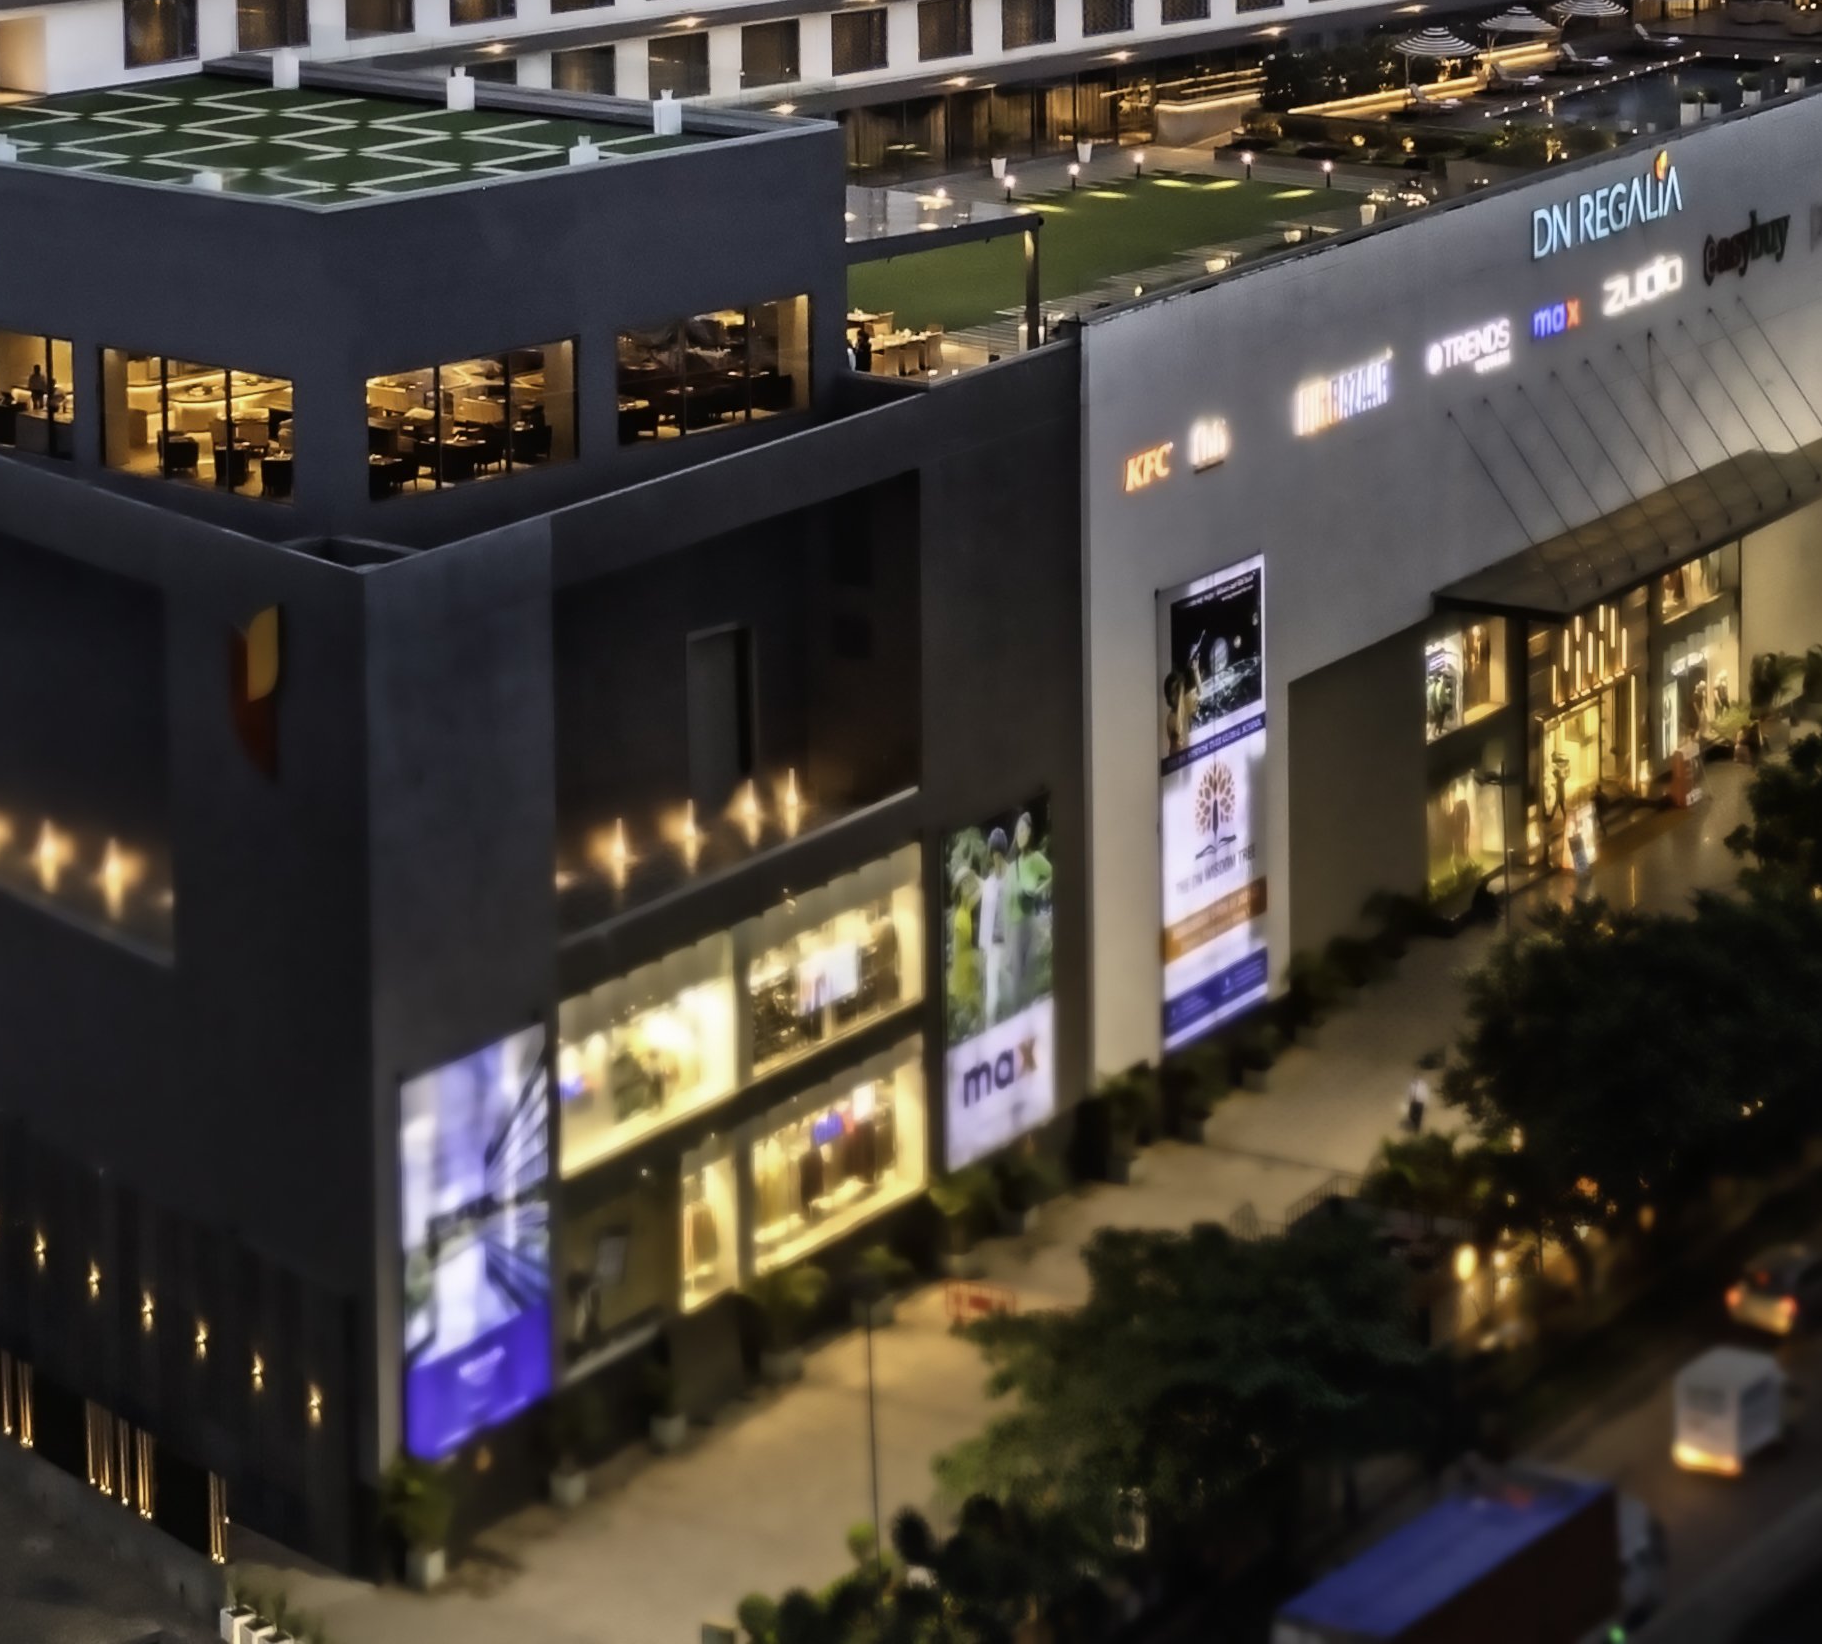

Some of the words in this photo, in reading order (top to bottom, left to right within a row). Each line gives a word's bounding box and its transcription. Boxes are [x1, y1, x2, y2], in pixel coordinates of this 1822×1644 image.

[1533, 202, 1572, 259] DN
[1580, 156, 1683, 244] REGALIA
[1442, 318, 1511, 368] TRENDS
[1534, 299, 1580, 337] max
[1125, 442, 1172, 492] KFC
[963, 1037, 1038, 1108] max
